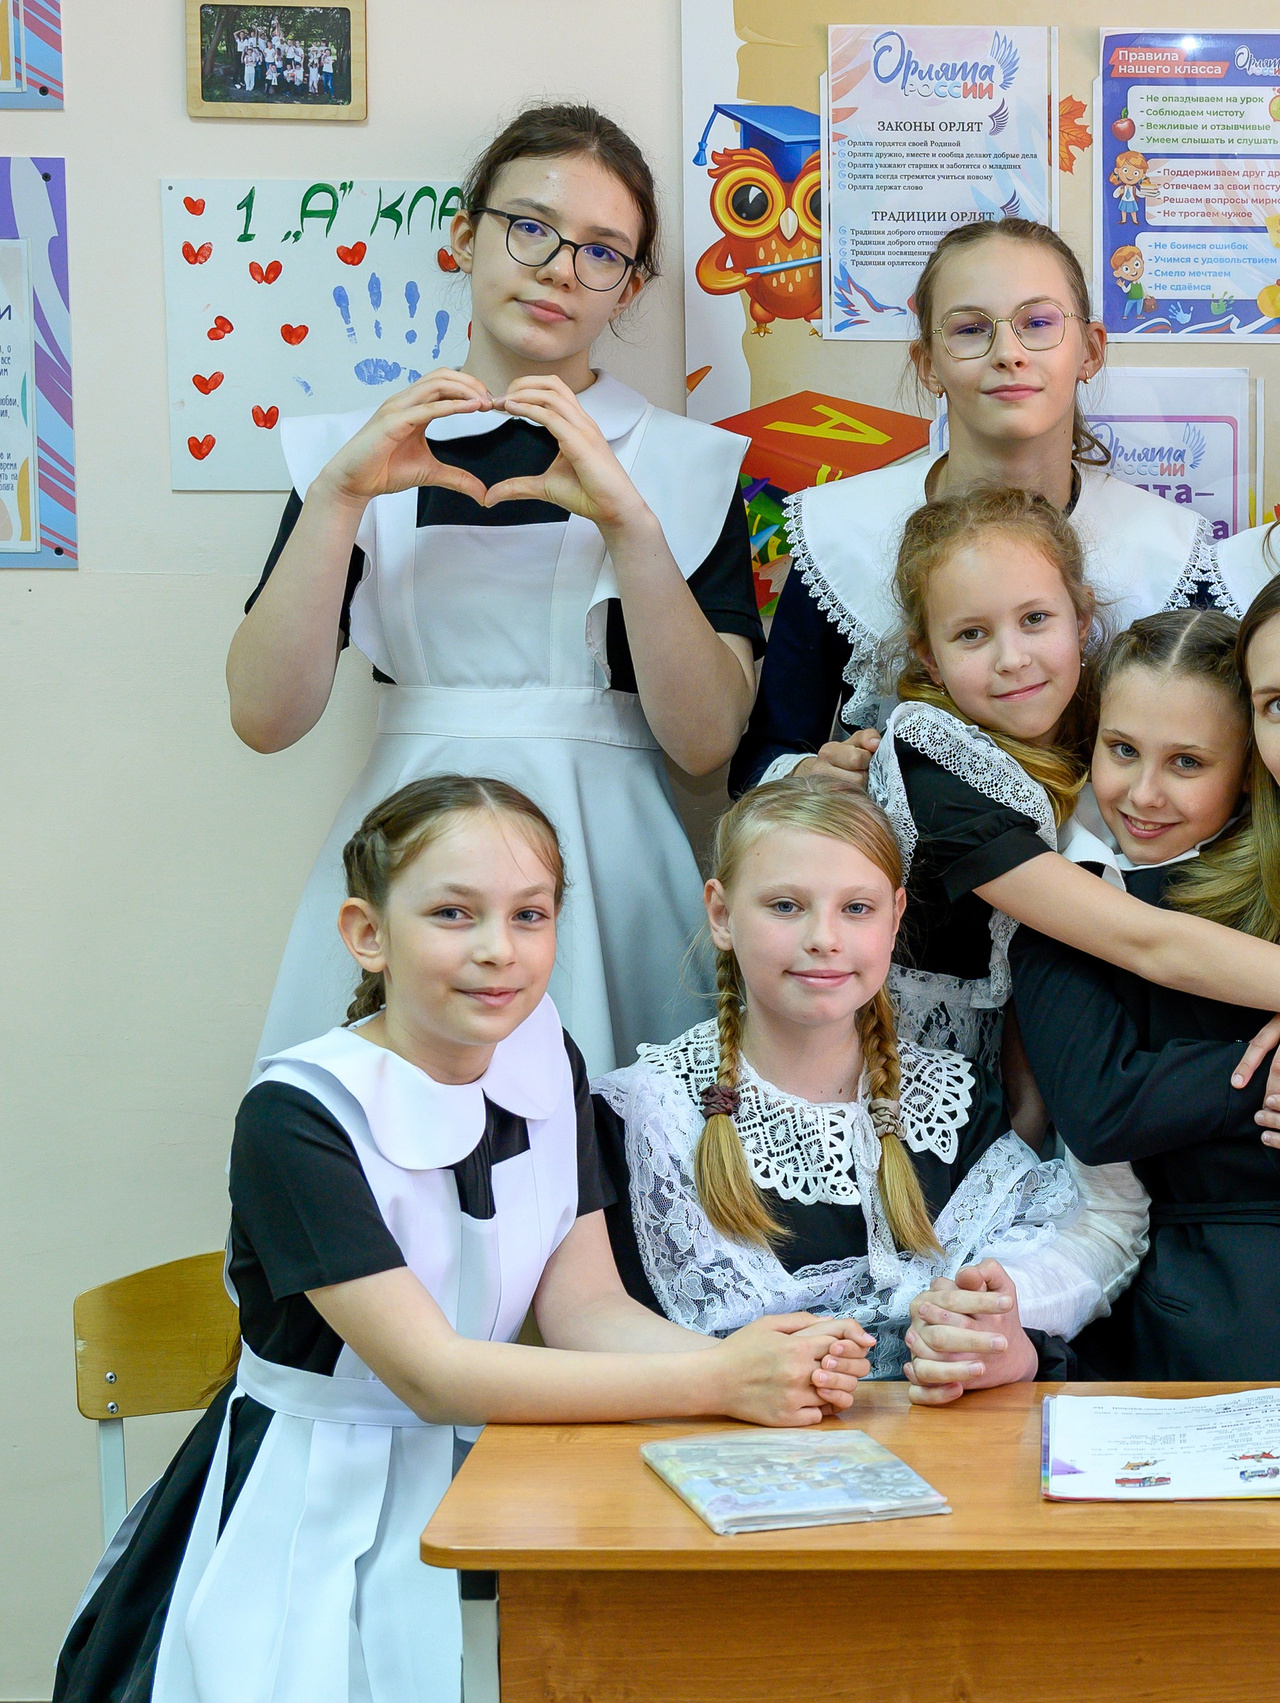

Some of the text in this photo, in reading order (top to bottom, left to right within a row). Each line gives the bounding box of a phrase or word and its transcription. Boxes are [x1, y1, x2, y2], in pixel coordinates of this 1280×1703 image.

[873, 31, 995, 89] Орлята
[1118, 50, 1179, 61] Правила
[1118, 64, 1221, 75] нашего класса
[1162, 96, 1223, 104] опаздываем
[1146, 109, 1245, 118] Соблюдаем чистоту
[878, 121, 983, 132] ЗАКОНЫ ОРЛЯТ
[1147, 123, 1198, 131] Вежливые
[1163, 169, 1240, 178] Поддерживаем
[1242, 170, 1265, 178] друг
[237, 186, 255, 242] 1
[370, 186, 465, 240] КЛА
[872, 211, 994, 222] ТРАДИЦИИ ОРЛЯТ
[1170, 242, 1206, 250] боимся
[1209, 242, 1248, 250] ошибок
[1170, 283, 1211, 291] сдаёмся
[1, 356, 11, 364] все
